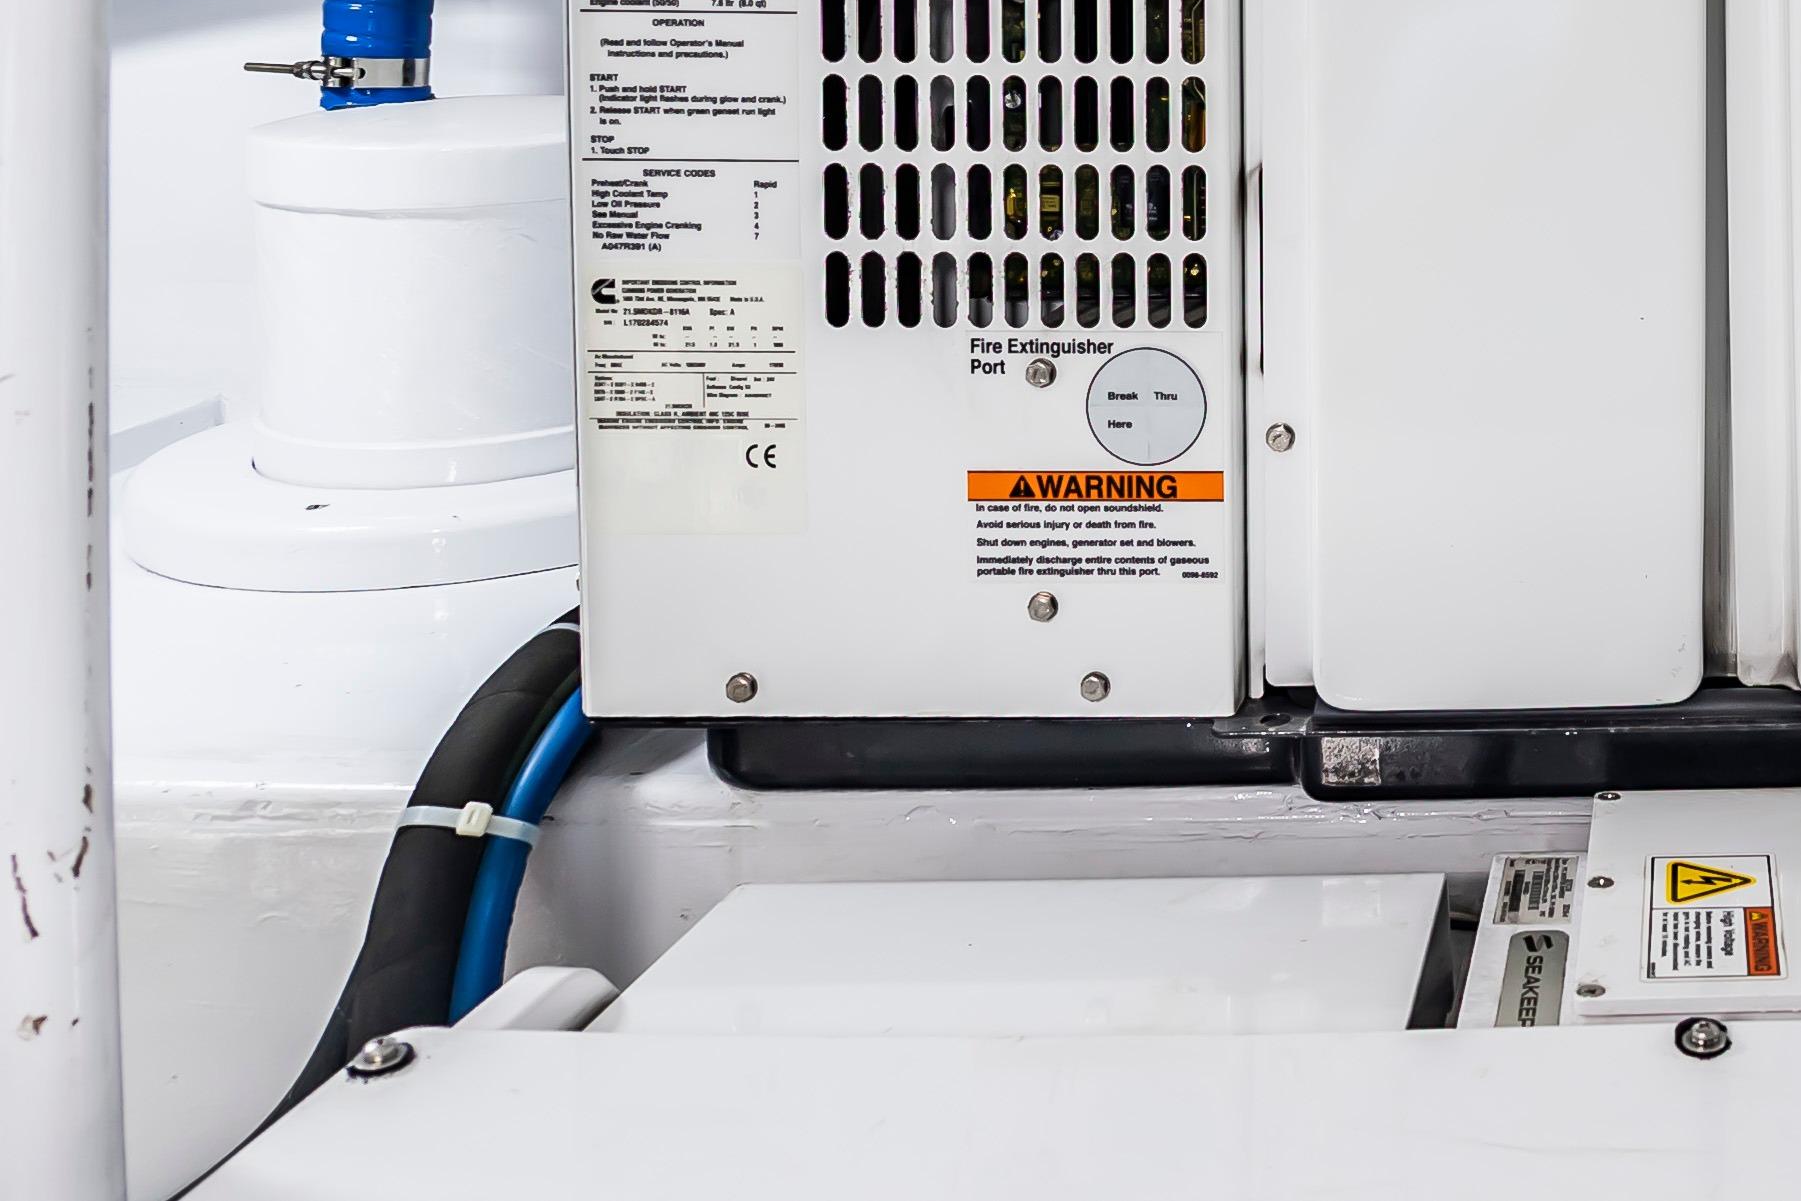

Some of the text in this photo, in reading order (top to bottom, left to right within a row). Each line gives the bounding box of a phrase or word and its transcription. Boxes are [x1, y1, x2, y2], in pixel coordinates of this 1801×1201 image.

[652, 19, 704, 27] OPERATION
[659, 85, 687, 93] START
[640, 94, 658, 104] light
[691, 96, 717, 104] during
[719, 96, 739, 104] glow
[634, 106, 661, 114] START
[758, 108, 775, 117] light
[591, 135, 614, 143] STOP
[600, 146, 625, 154] Touch
[643, 169, 681, 177] SERVICE
[754, 180, 777, 189] Rapid
[591, 190, 610, 199] High
[646, 190, 668, 199] Temp
[592, 200, 660, 208] Low Oil Pressure
[635, 221, 663, 231] Engine
[665, 221, 702, 231] Cranking
[592, 231, 604, 239] No
[648, 243, 661, 252] (A)
[971, 338, 1113, 357] Fire Extinguisher
[971, 359, 1005, 374] Port
[1108, 392, 1177, 400] Break Thru
[1108, 420, 1132, 428] Here
[746, 443, 777, 468] CE
[1038, 475, 1178, 499] WARNING
[1024, 504, 1042, 512] fire,
[1045, 504, 1057, 512] do
[1060, 504, 1075, 512] not
[1077, 505, 1100, 514] open
[1104, 504, 1164, 512] soundshield.
[976, 520, 1003, 528] Avoid
[1006, 520, 1041, 528] serious
[1044, 520, 1070, 531] injury
[1085, 520, 1111, 528] death
[1114, 520, 1136, 529] from
[1139, 520, 1156, 528] fire.
[977, 538, 998, 546] Shut
[1001, 538, 1027, 546] down
[1029, 538, 1069, 549] engines,
[1072, 539, 1117, 549] generator
[1157, 538, 1196, 547] blowers.
[977, 555, 1033, 566] Immediately
[1036, 556, 1083, 566] discharge
[1085, 556, 1112, 564] entire
[1114, 556, 1155, 564] contents
[1170, 557, 1209, 566] gaseous
[977, 567, 1160, 577] portable fire extinguisher thru this port.
